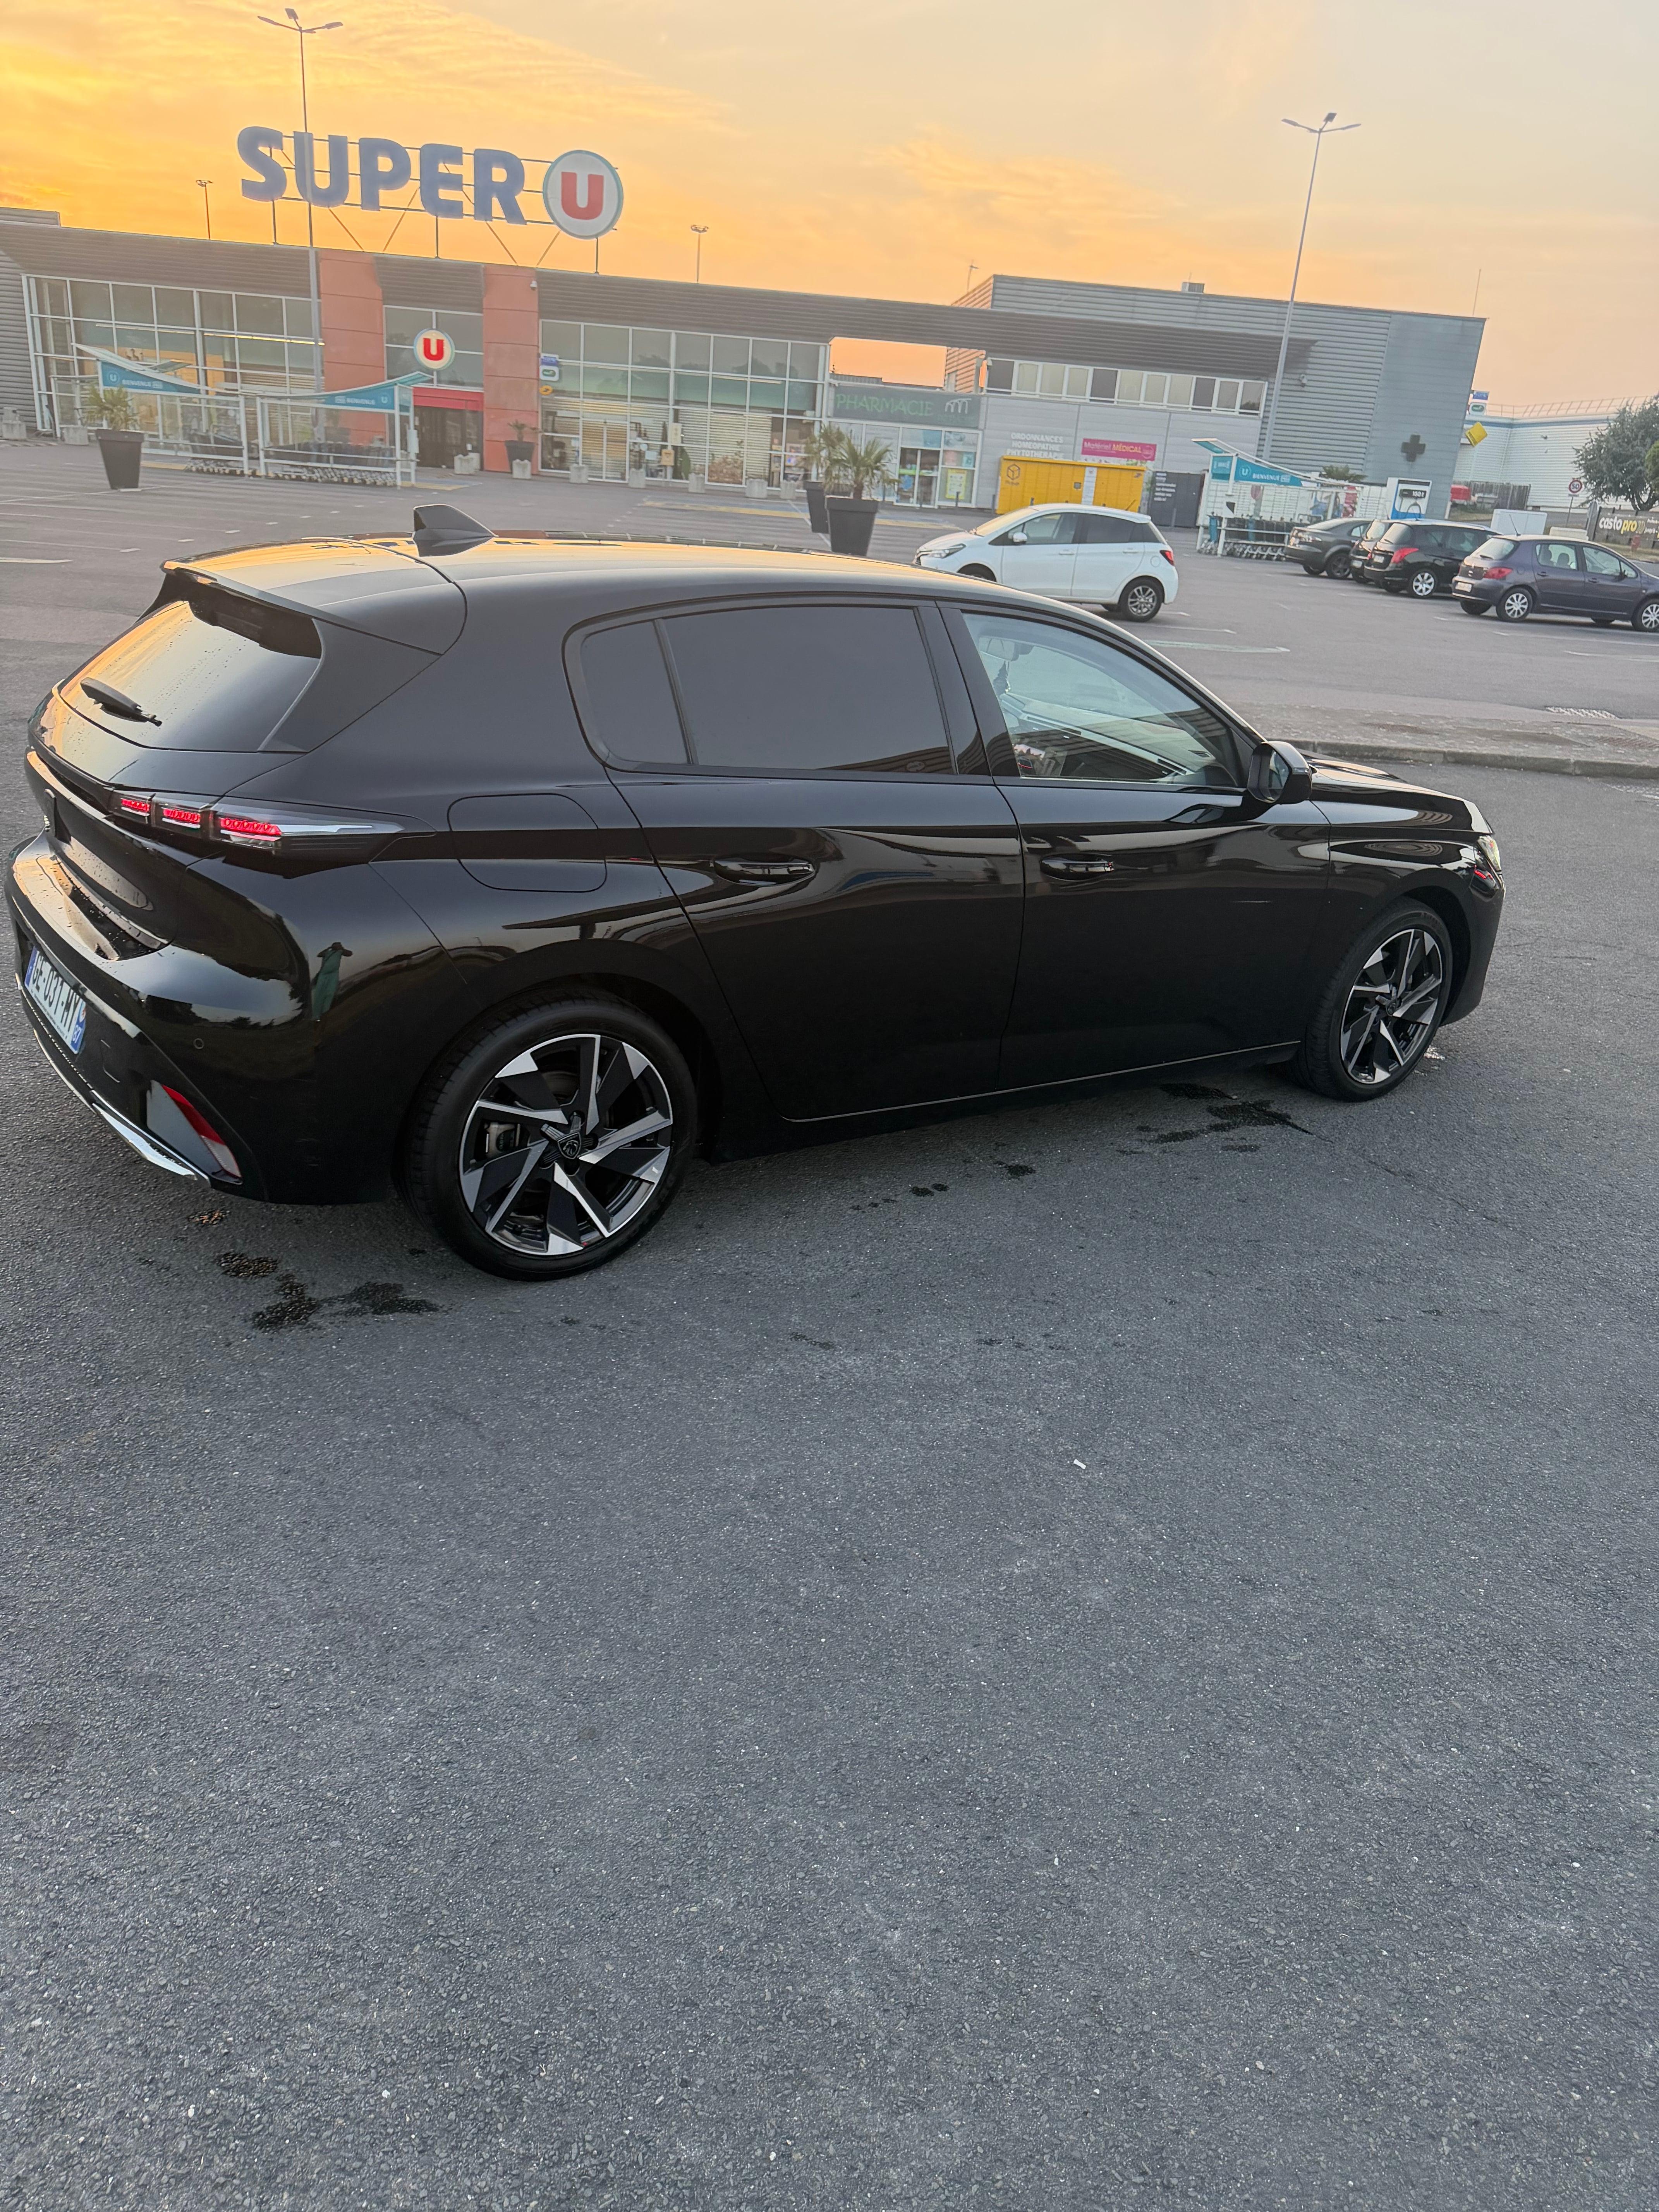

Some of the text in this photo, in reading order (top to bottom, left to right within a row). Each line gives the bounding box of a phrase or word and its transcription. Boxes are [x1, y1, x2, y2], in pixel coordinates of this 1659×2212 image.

[237, 126, 604, 225] SUPER U
[423, 337, 445, 361] U
[836, 393, 935, 416] PHARMACIE
[1011, 433, 1064, 443] ORDONNANCES
[72, 1024, 82, 1043] 87
